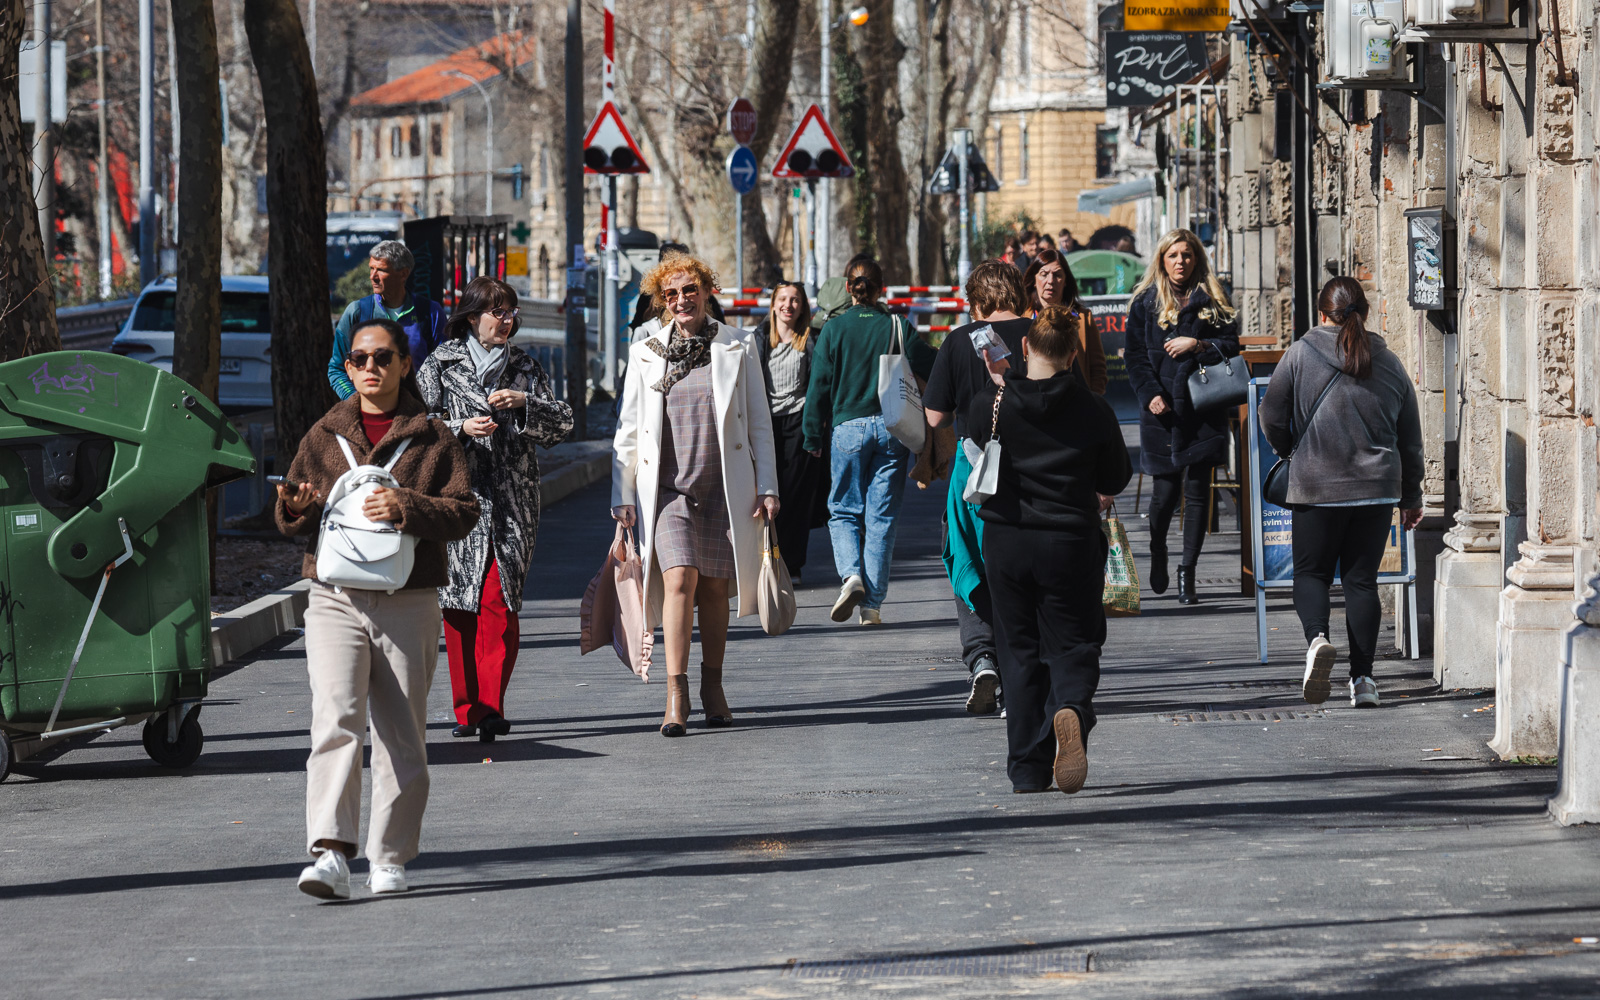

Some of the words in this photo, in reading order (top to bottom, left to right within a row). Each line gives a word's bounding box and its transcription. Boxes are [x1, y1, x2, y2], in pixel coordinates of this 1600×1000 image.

[1127, 6, 1181, 17] IZOBRAZBA
[1128, 33, 1182, 42] srebrnarnica
[732, 111, 756, 131] STOP
[1263, 518, 1282, 526] svim
